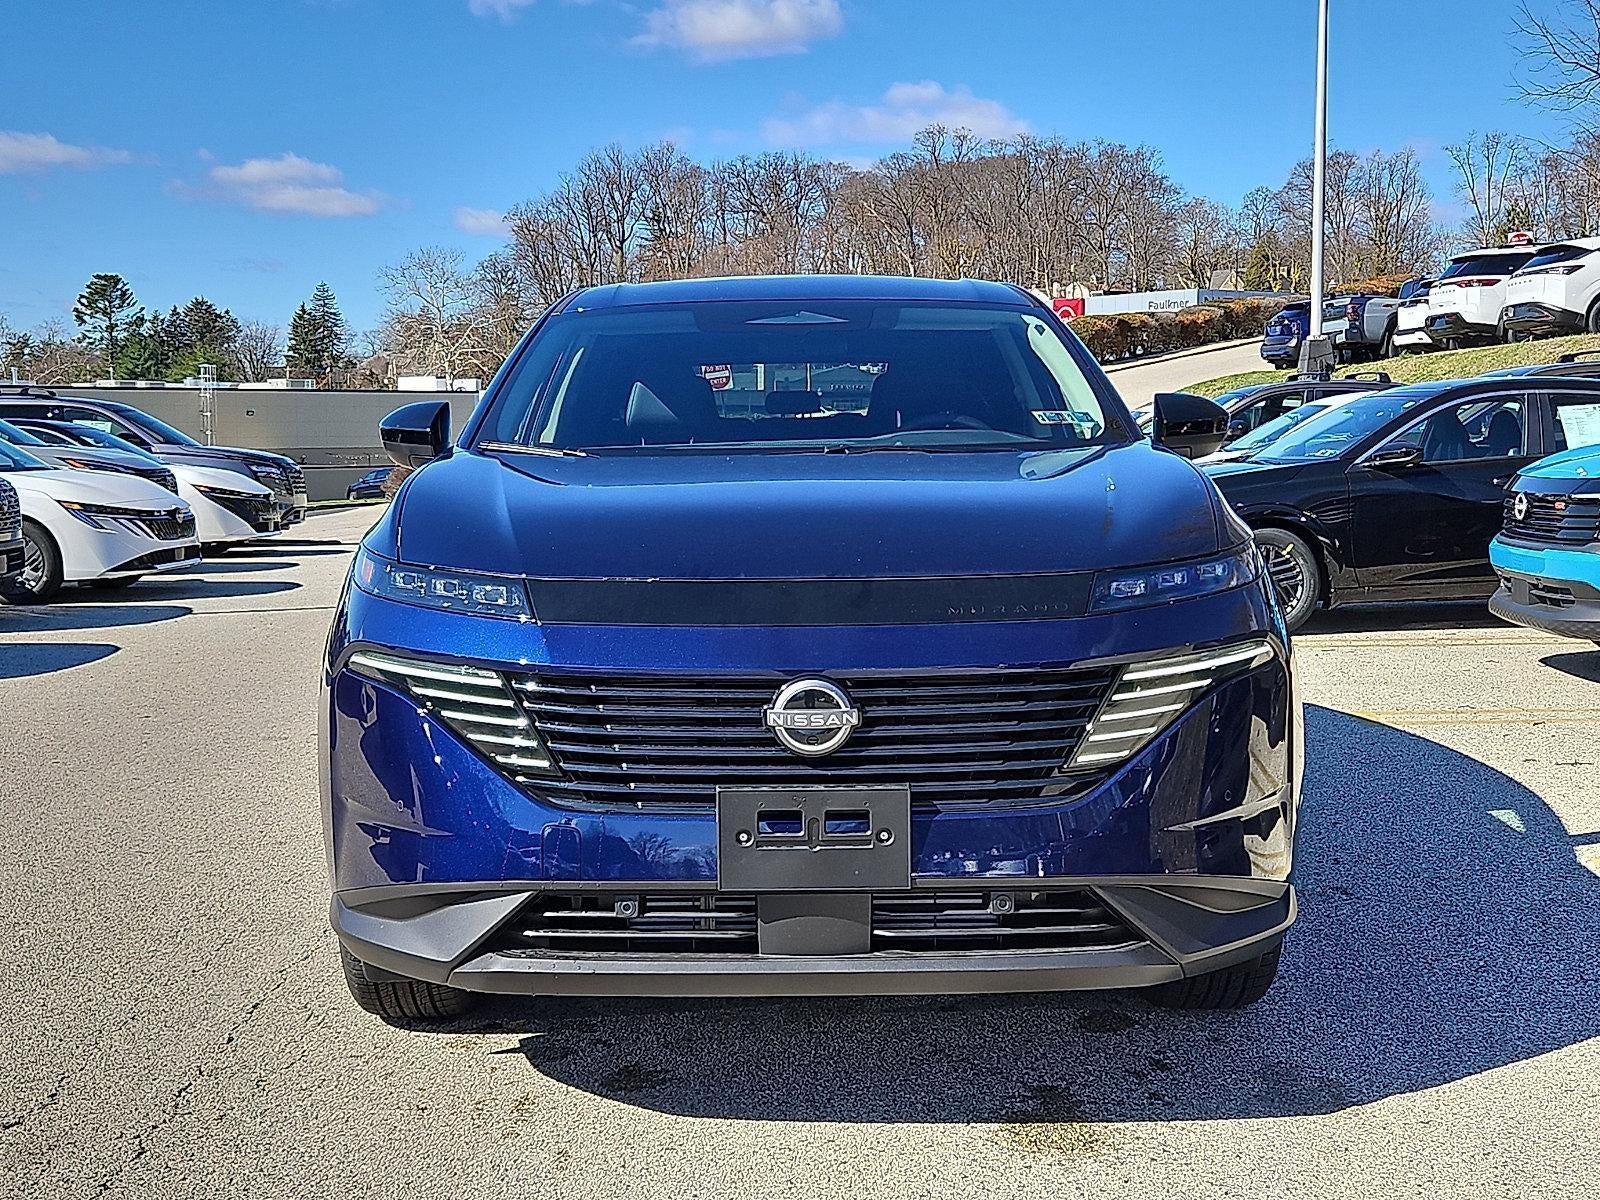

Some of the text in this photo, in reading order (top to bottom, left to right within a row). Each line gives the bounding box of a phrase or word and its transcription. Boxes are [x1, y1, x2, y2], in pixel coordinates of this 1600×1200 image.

[1148, 300, 1189, 310] Faulkner
[947, 603, 1068, 615] MURANO
[769, 711, 856, 726] NISSAN
